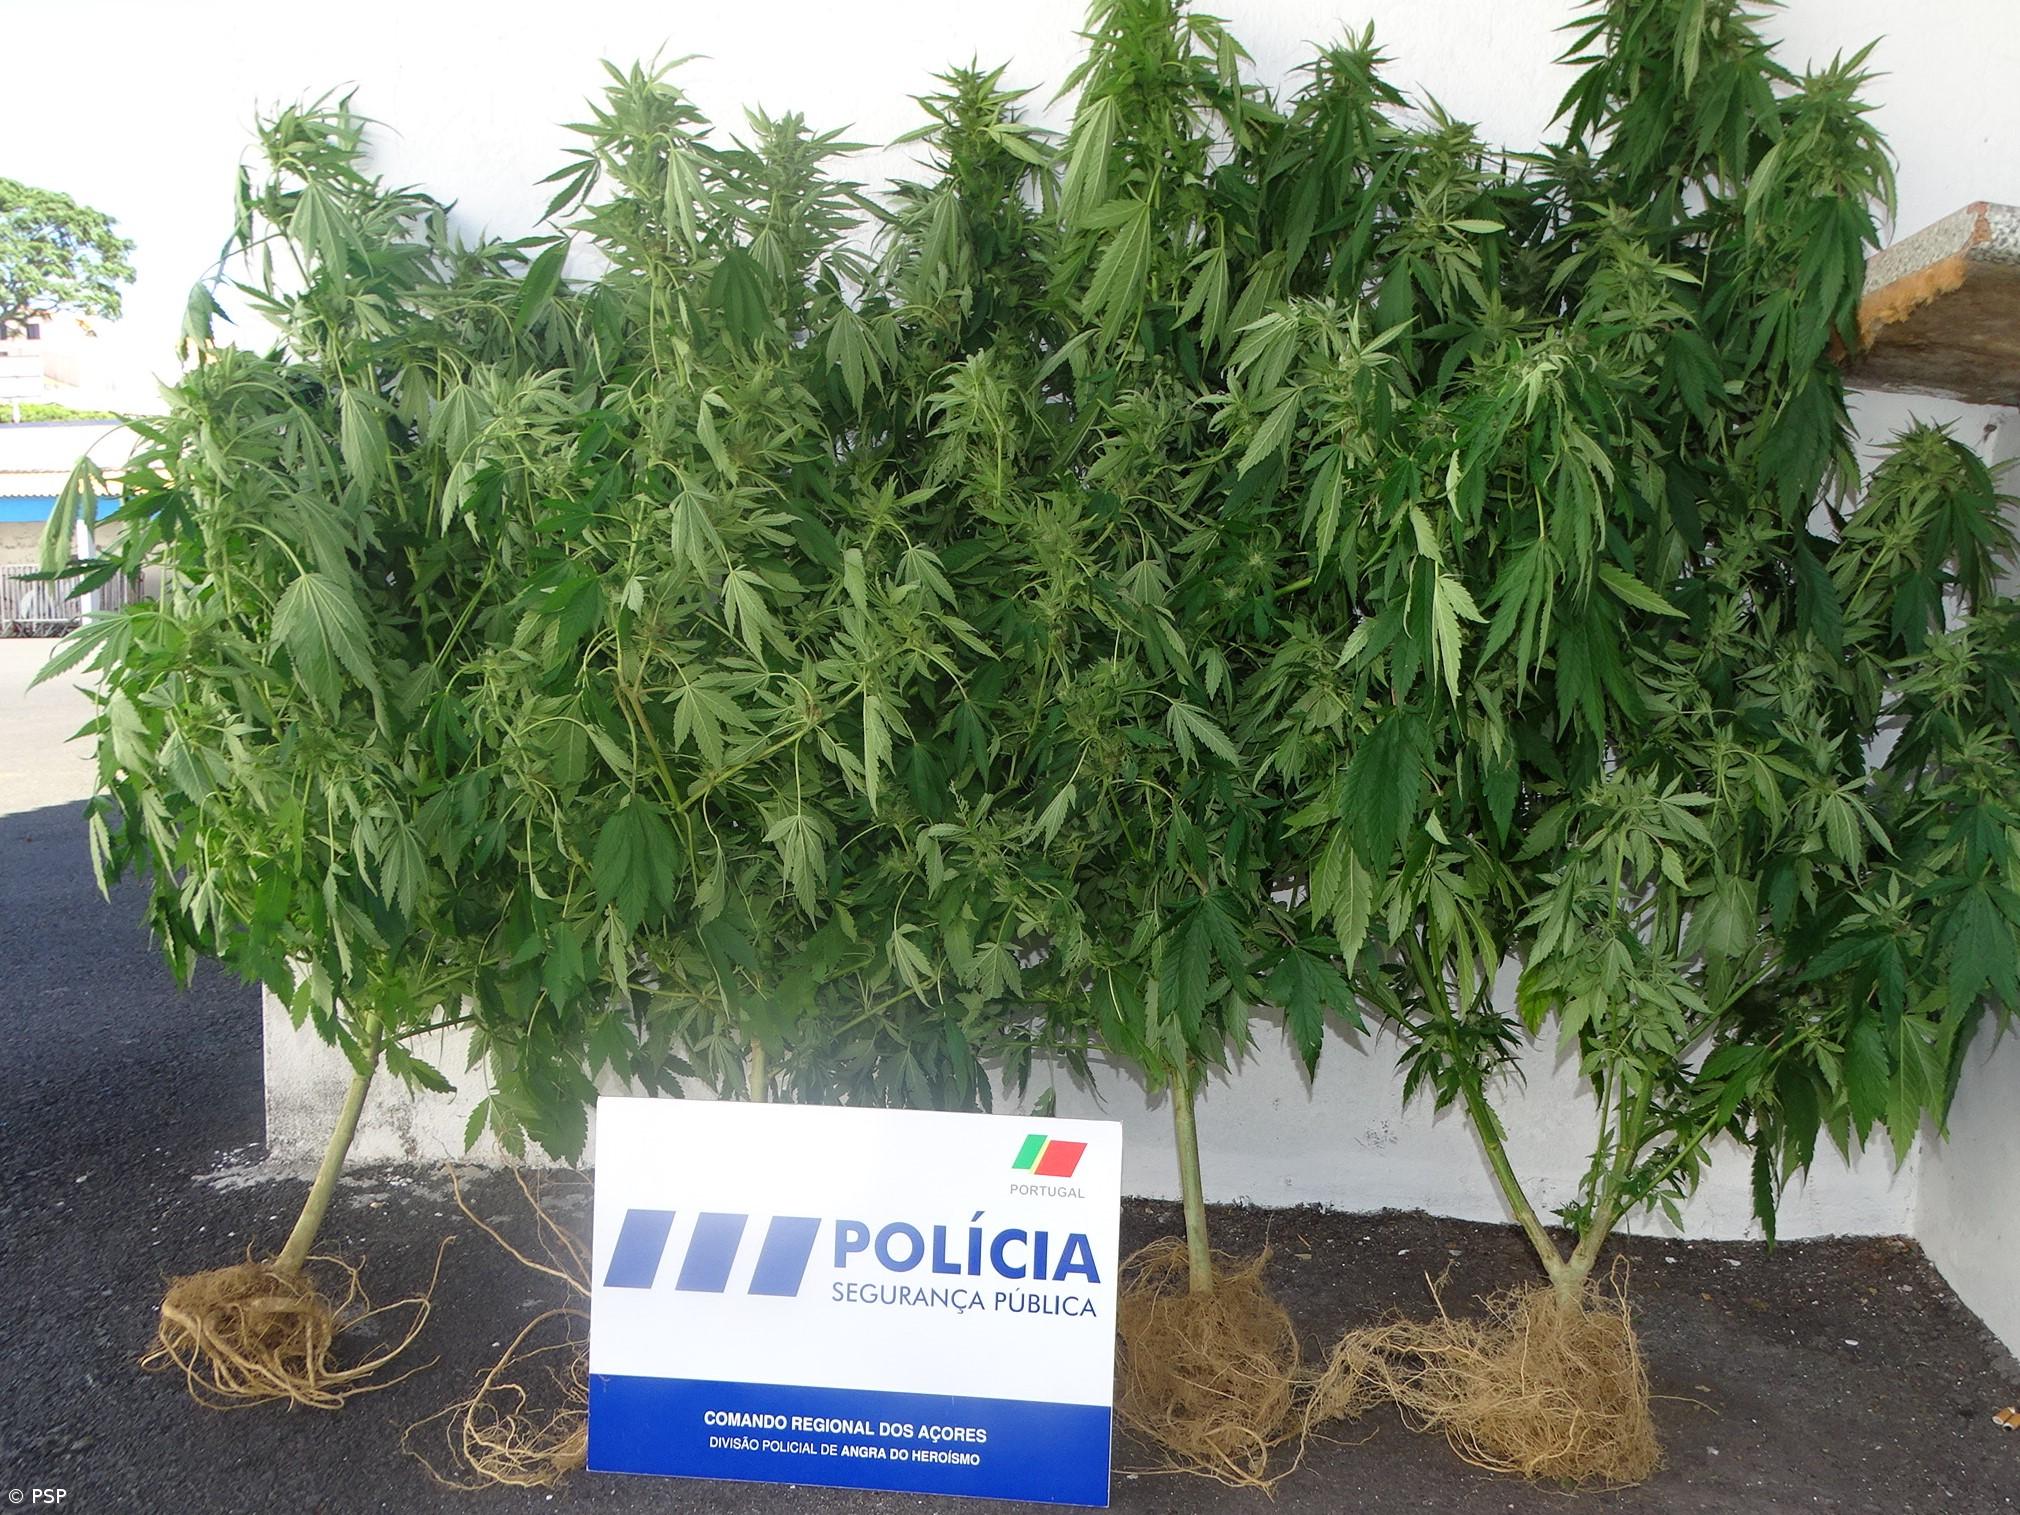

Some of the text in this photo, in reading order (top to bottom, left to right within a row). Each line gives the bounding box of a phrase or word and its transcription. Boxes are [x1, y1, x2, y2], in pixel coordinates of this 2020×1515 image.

[1009, 1183, 1086, 1199] PORTUGAL
[834, 1210, 1101, 1284] POLÍCIA
[832, 1281, 1097, 1317] SEGURANÇA PÚBLICA
[703, 1410, 987, 1444] COMANDO REGIONAL DOS AÇORES
[709, 1435, 981, 1466] DIVISÃO POLICIAL DE ANGRA DO HEROÍSMO
